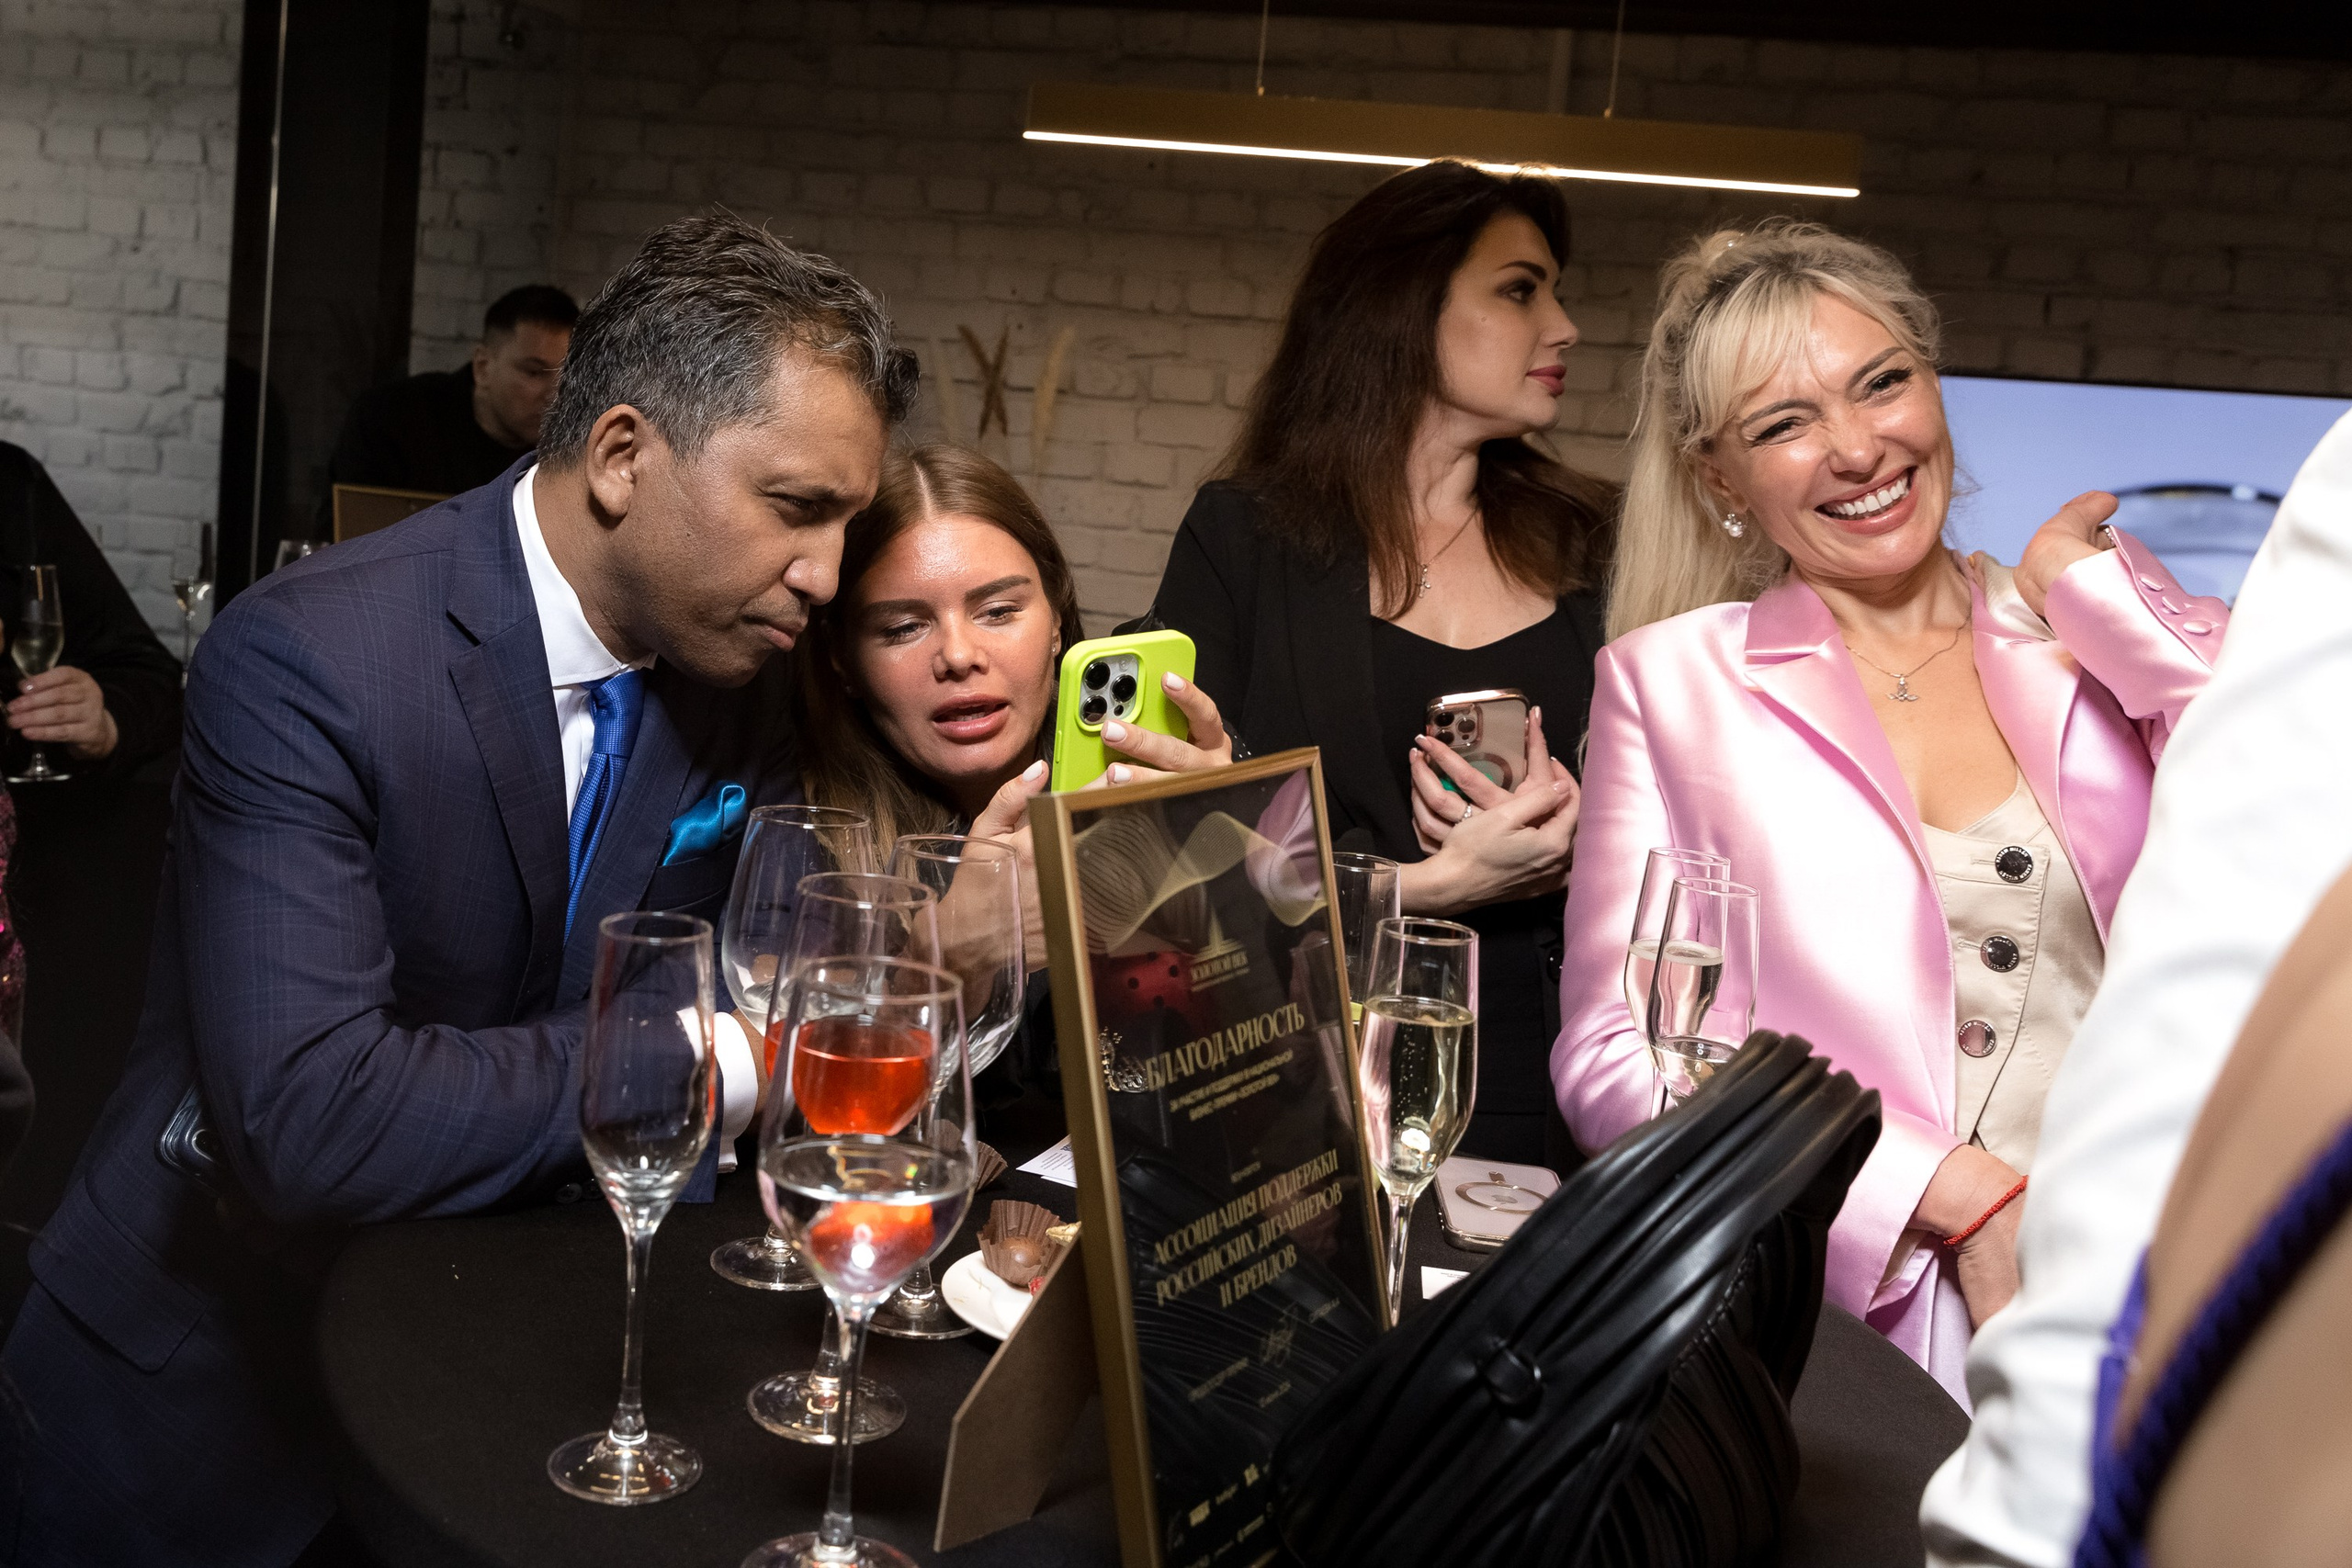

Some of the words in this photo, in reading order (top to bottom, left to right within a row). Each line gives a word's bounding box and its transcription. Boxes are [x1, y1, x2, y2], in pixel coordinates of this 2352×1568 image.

[1145, 1002, 1306, 1091] БЛАГОДАРНОСТЬ
[1154, 1190, 1258, 1265] АССОЦИАЦИЯ
[1258, 1148, 1339, 1211] ПОДДЕРЖКИ
[1156, 1229, 1256, 1308] РОССИЙСКИХ
[1257, 1182, 1342, 1254] ДИЗАЙНЕРОВ
[1219, 1281, 1233, 1308] И
[1233, 1244, 1297, 1301] БРЕНДОВ
